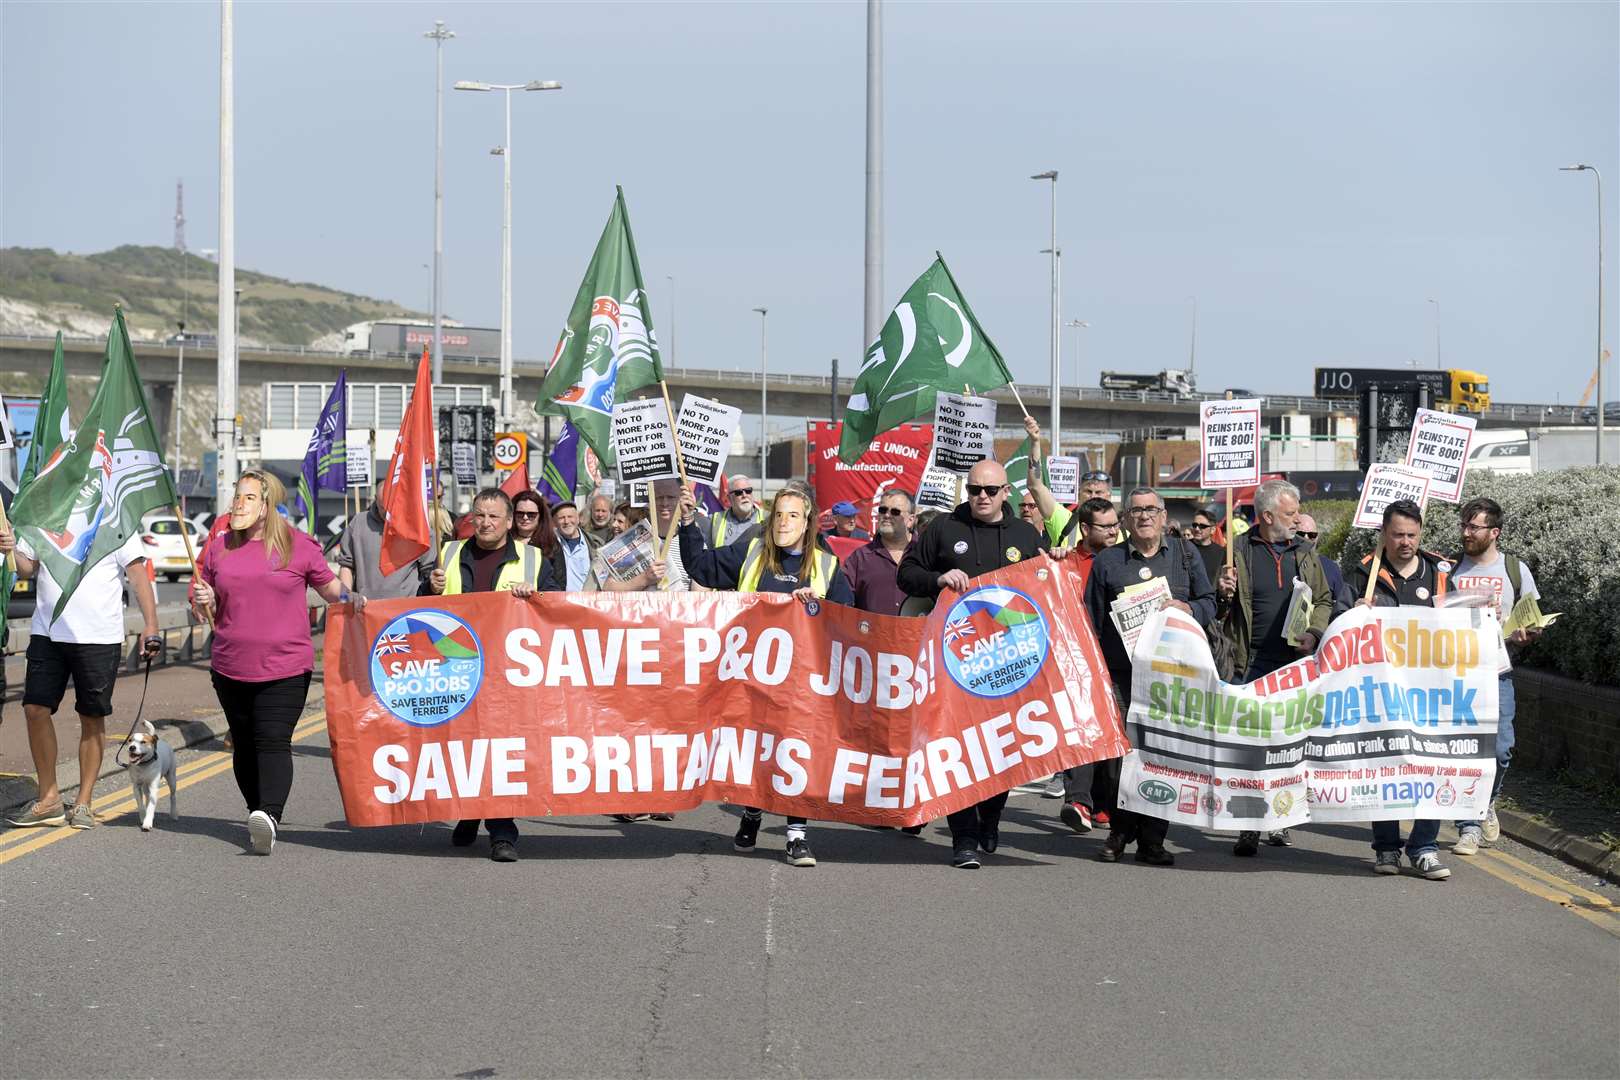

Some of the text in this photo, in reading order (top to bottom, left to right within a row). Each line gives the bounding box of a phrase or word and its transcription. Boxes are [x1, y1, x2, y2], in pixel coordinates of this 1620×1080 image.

[1321, 372, 1353, 389] JJO
[683, 409, 710, 422] NO TO
[940, 405, 966, 418] NO TO
[615, 418, 628, 426] NO
[616, 422, 668, 436] MORE P&Os
[680, 419, 729, 438] MORE P&Os
[938, 416, 990, 430] MORE P&Os
[1207, 422, 1254, 433] REINSTATE
[618, 432, 663, 446] FIGHT FOR
[677, 428, 721, 446] FIGHT FOR
[938, 426, 983, 440] FIGHT FOR
[1208, 433, 1254, 447] THE 800!
[1419, 430, 1466, 448] REINSTATE
[620, 442, 666, 456] EVERY JOB
[680, 440, 719, 456] VERY JOB
[937, 435, 983, 449] EVERY JOB
[497, 444, 518, 458] 30
[884, 442, 919, 459] UNION
[937, 449, 952, 457] Stop
[1210, 452, 1253, 462] NATIONALISE
[1417, 442, 1463, 461] THE 800!
[1500, 446, 1519, 455] XF
[623, 460, 637, 468] Stop
[638, 458, 650, 466] this
[642, 463, 667, 471] bottom
[955, 458, 978, 466] botto
[1371, 487, 1393, 497] THE
[1372, 477, 1422, 493] REINSTATE
[1460, 577, 1502, 589] TUSC
[960, 630, 1008, 661] SAVE
[1384, 619, 1480, 677] shop
[960, 637, 1040, 680] P&O JOBS
[390, 658, 441, 679] SAVE
[504, 627, 936, 710] SAVE P&O JOBS!
[969, 654, 1040, 689] SAVE BRITAIN'S
[384, 675, 471, 697] P&O JOBS
[990, 670, 1026, 690] FERRIES
[391, 693, 466, 709] SAVE BRITAIN'S
[1149, 675, 1478, 739] stewards network
[412, 705, 449, 717] FERRIES
[372, 737, 528, 804] SAVE
[828, 690, 1083, 809] FERRIES!
[1303, 742, 1323, 757] the
[1325, 739, 1355, 756] union
[1357, 738, 1386, 754] rank
[1388, 735, 1410, 751] and
[1450, 739, 1479, 755] 2006
[1142, 761, 1213, 784] shopstewards.net
[1313, 768, 1362, 781] supported
[1365, 766, 1377, 780] by
[1380, 765, 1395, 777] the
[1399, 763, 1435, 778] following
[1146, 786, 1170, 799] RMT
[1352, 784, 1378, 795] NUJ
[1382, 779, 1435, 802] napo
